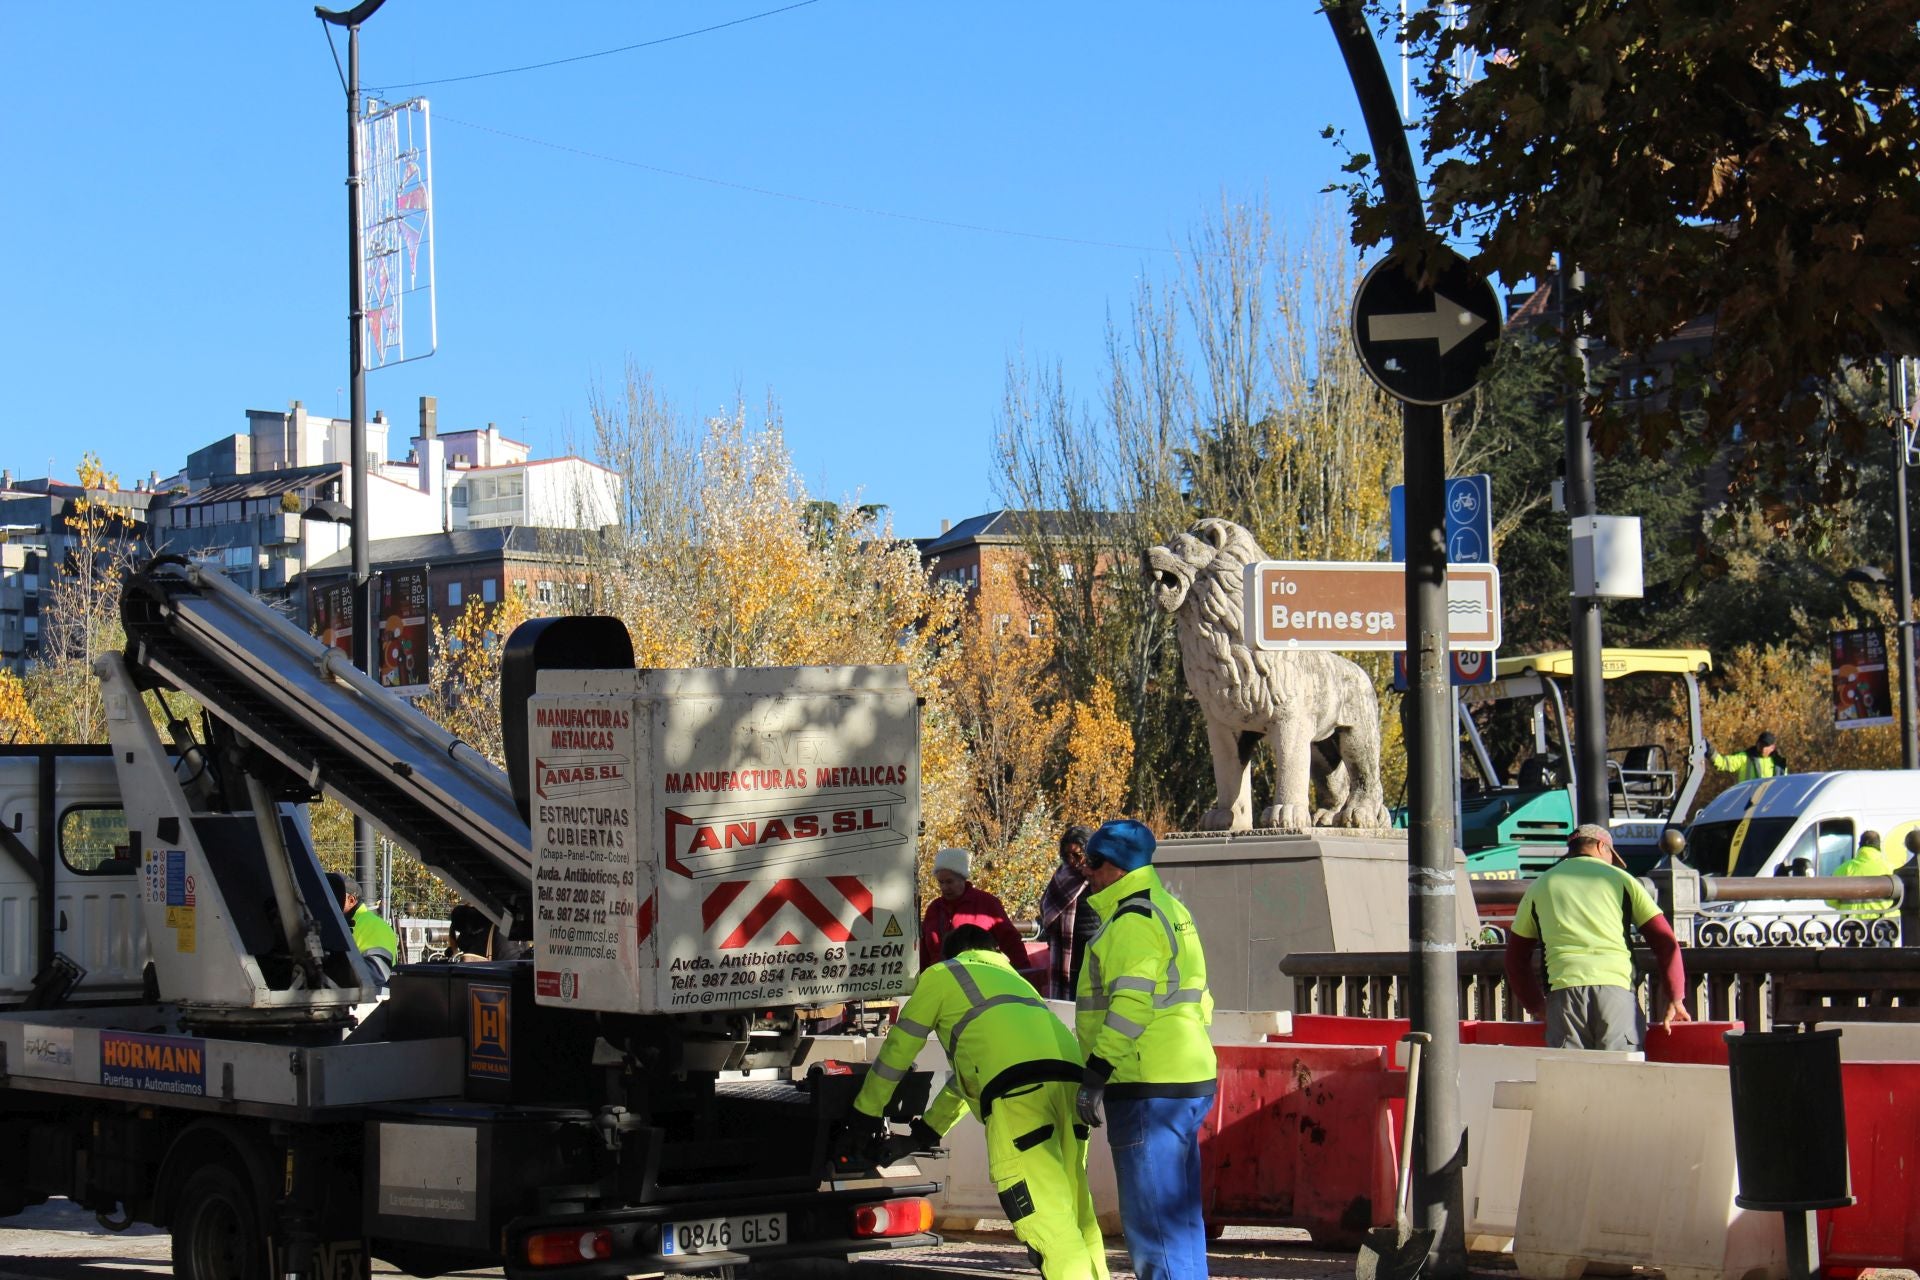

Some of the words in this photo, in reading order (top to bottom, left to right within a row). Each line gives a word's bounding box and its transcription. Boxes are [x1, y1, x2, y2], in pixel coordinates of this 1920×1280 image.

[411, 575, 421, 584] SA
[411, 584, 422, 595] BO
[1271, 577, 1297, 595] río
[411, 594, 425, 605] RES
[1271, 604, 1396, 634] Bernesga
[1461, 652, 1479, 666] 20
[536, 708, 629, 729] MANUFACTURAS
[551, 730, 614, 751] METALICAS
[665, 769, 808, 794] MANUFACTURAS
[815, 765, 908, 788] METALICAS
[539, 805, 629, 828] ESTRUCTURAS
[547, 827, 624, 849] CUBIERTAS
[536, 865, 561, 882] Avda.
[622, 870, 634, 886] 63
[538, 886, 554, 901] Telf.
[555, 888, 572, 903] 987
[573, 889, 589, 904] 200
[590, 890, 605, 905] 854
[538, 905, 554, 921] Fax.
[556, 907, 573, 922] 987
[574, 908, 590, 924] 254
[592, 910, 606, 925] 112
[608, 898, 634, 917] LEÓN
[549, 925, 619, 945] info@mmcsl.es
[549, 944, 617, 961] www.mmcsl.es
[670, 956, 714, 972] Avda.
[719, 949, 819, 970] Antibioticos,
[824, 948, 844, 961] 63
[859, 942, 904, 960] LEÓN
[671, 974, 697, 990] Telf.
[702, 973, 728, 988] 987
[731, 971, 756, 986] 200
[759, 968, 785, 983] 854
[791, 967, 818, 981] Fax.
[821, 964, 847, 979] 987
[850, 962, 875, 977] 254
[881, 961, 903, 975] 112
[671, 987, 784, 1006] info@mmcsl.es
[797, 977, 903, 996] www.mmcsl.es
[104, 1073, 134, 1088] Puertas
[144, 1077, 202, 1096] Automatismos
[678, 1222, 732, 1250] 0846
[741, 1216, 781, 1243] GLS
